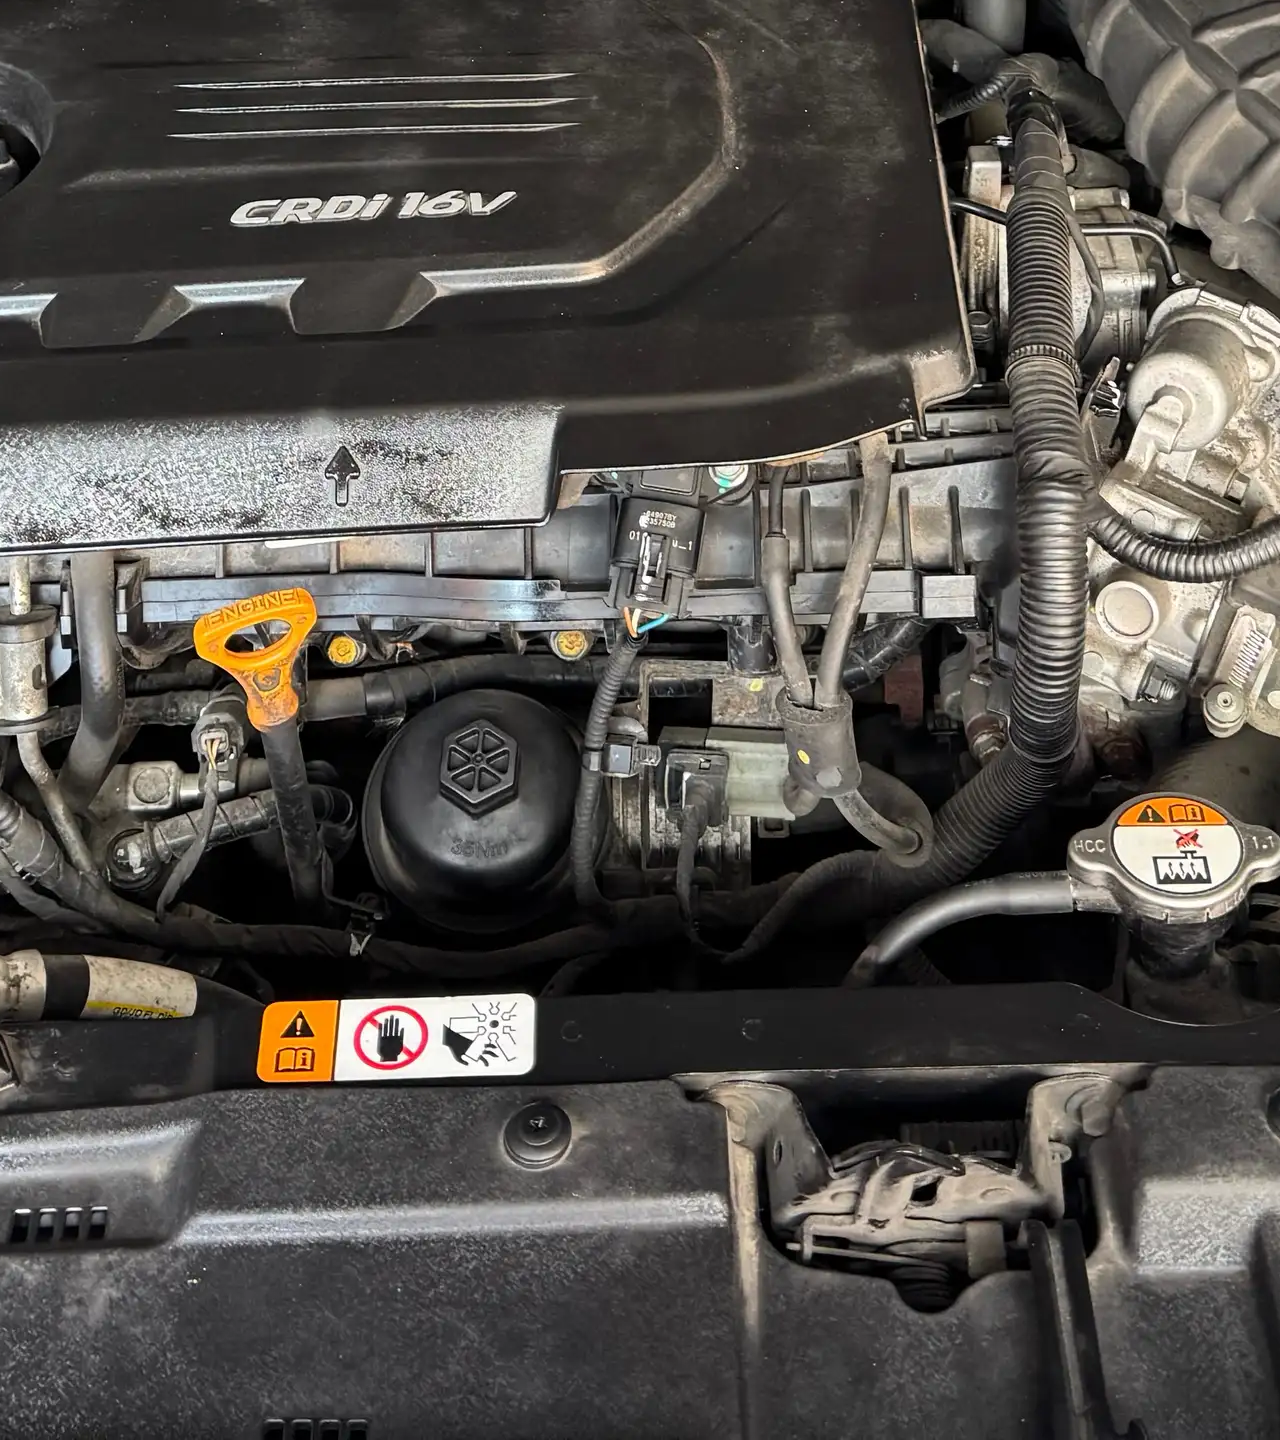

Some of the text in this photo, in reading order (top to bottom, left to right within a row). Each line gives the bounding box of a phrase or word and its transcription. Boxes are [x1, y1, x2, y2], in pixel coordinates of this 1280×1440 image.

[397, 190, 518, 218] 16V
[208, 588, 299, 627] ENGINE
[1074, 835, 1276, 854] HCC 1.1
